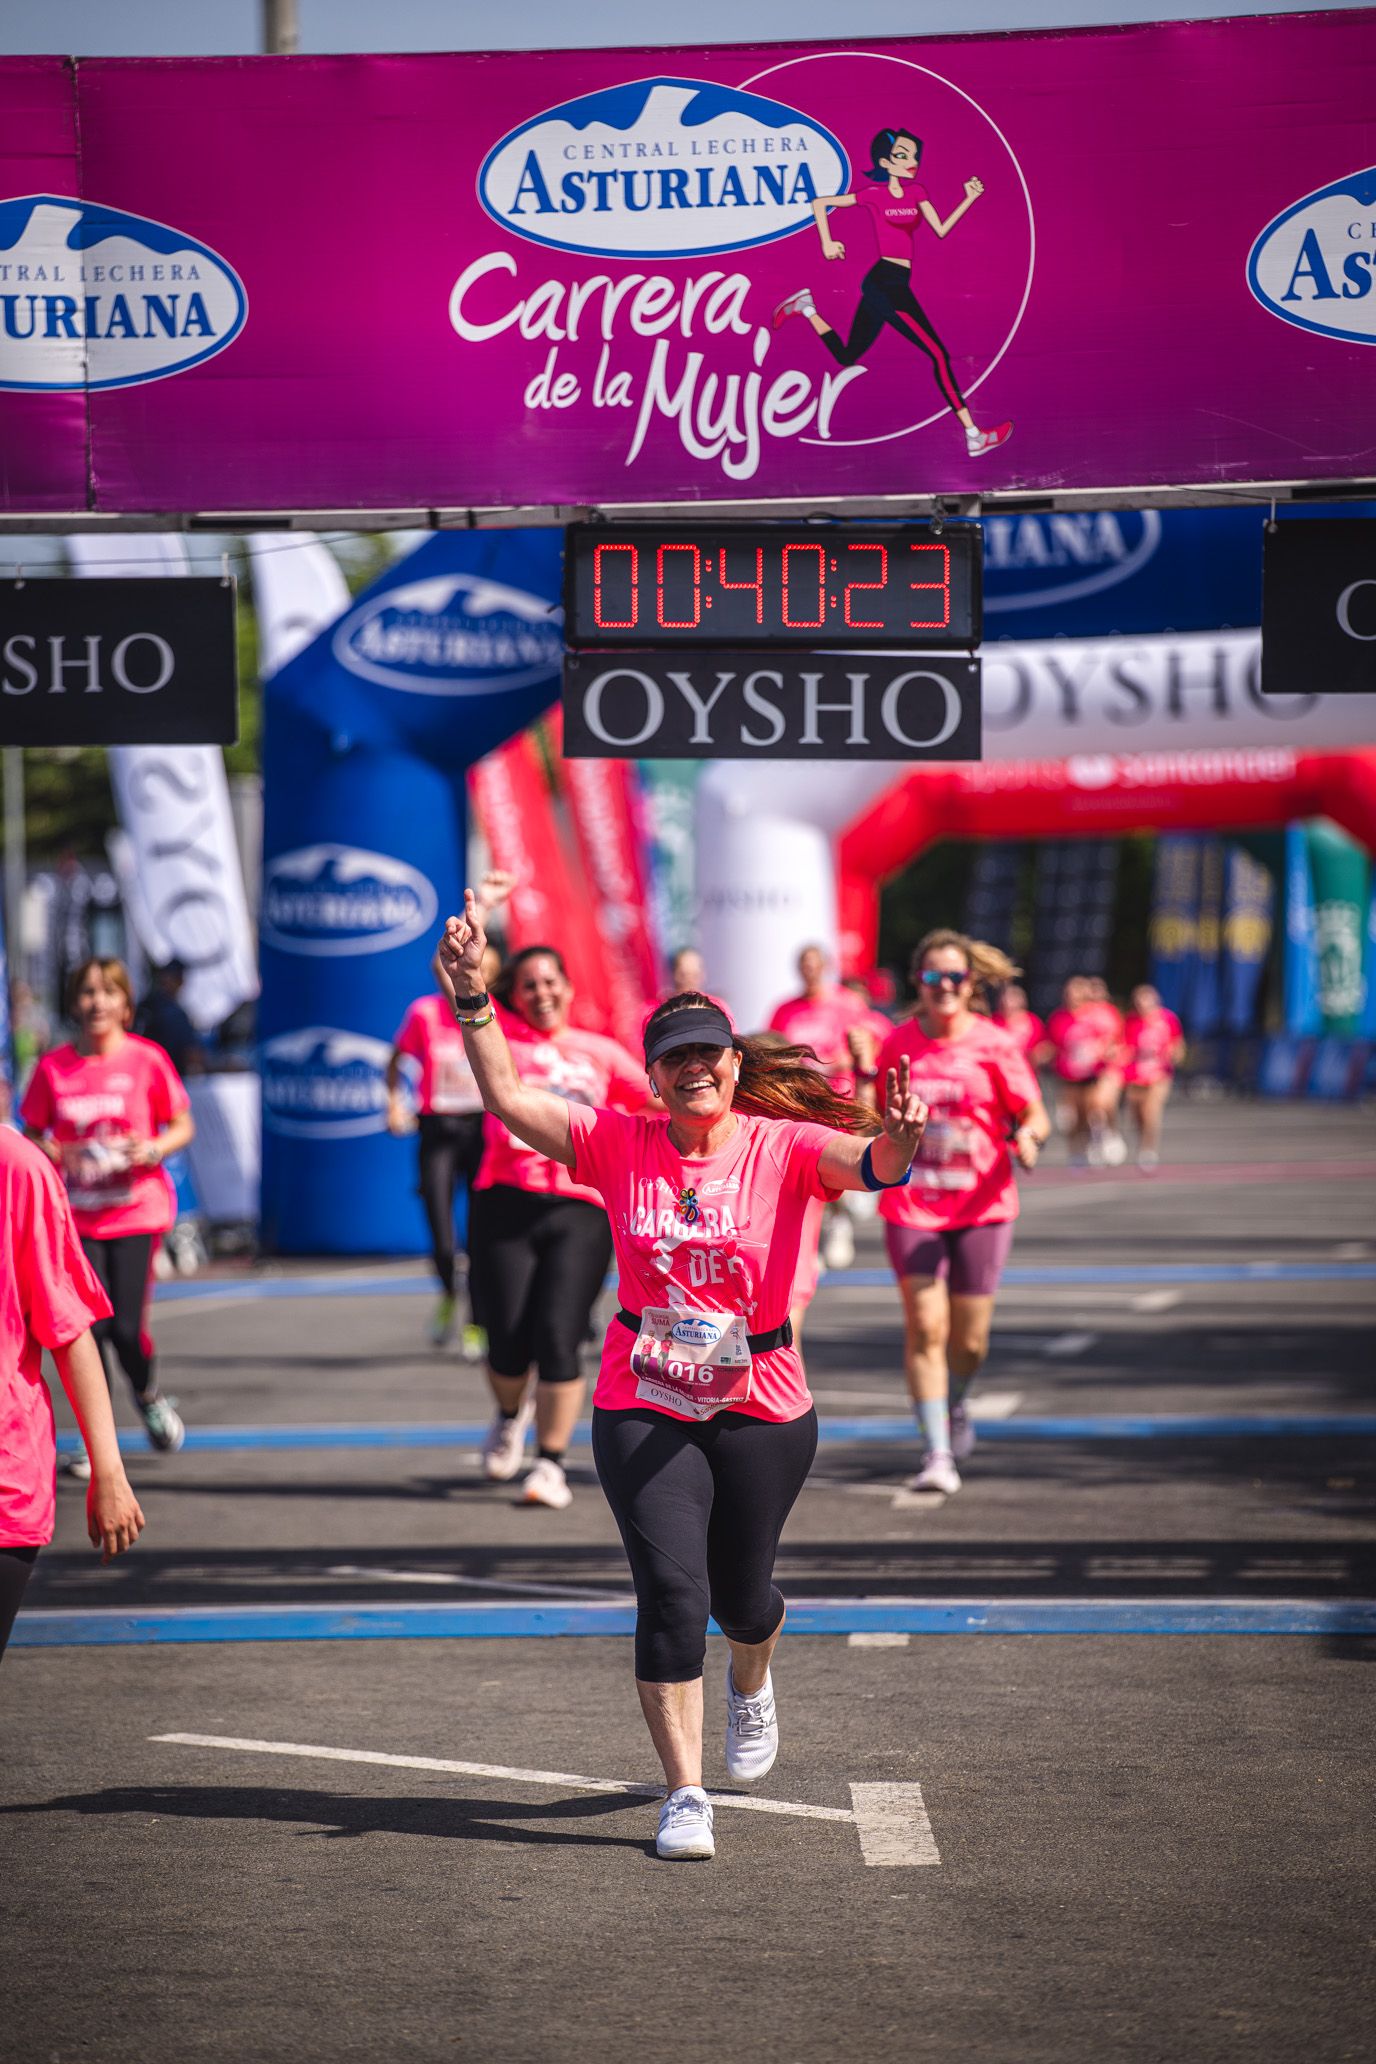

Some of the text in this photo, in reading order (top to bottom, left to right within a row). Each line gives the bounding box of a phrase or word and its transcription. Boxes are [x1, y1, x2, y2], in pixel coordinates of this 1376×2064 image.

[563, 137, 808, 160] CENTRAL LECHERA
[508, 150, 819, 214] ASTURIANA
[1281, 228, 1376, 301] AS
[0, 292, 217, 339] URIANA
[448, 251, 752, 342] Carrera
[524, 327, 868, 480] de la Mujer
[594, 544, 950, 628] 00:40:23
[1, 633, 175, 695] SHO
[583, 669, 962, 747] OYSHO
[689, 1248, 724, 1287] DE
[676, 1326, 718, 1340] ASTURIANA
[650, 1387, 682, 1407] OYSHO
